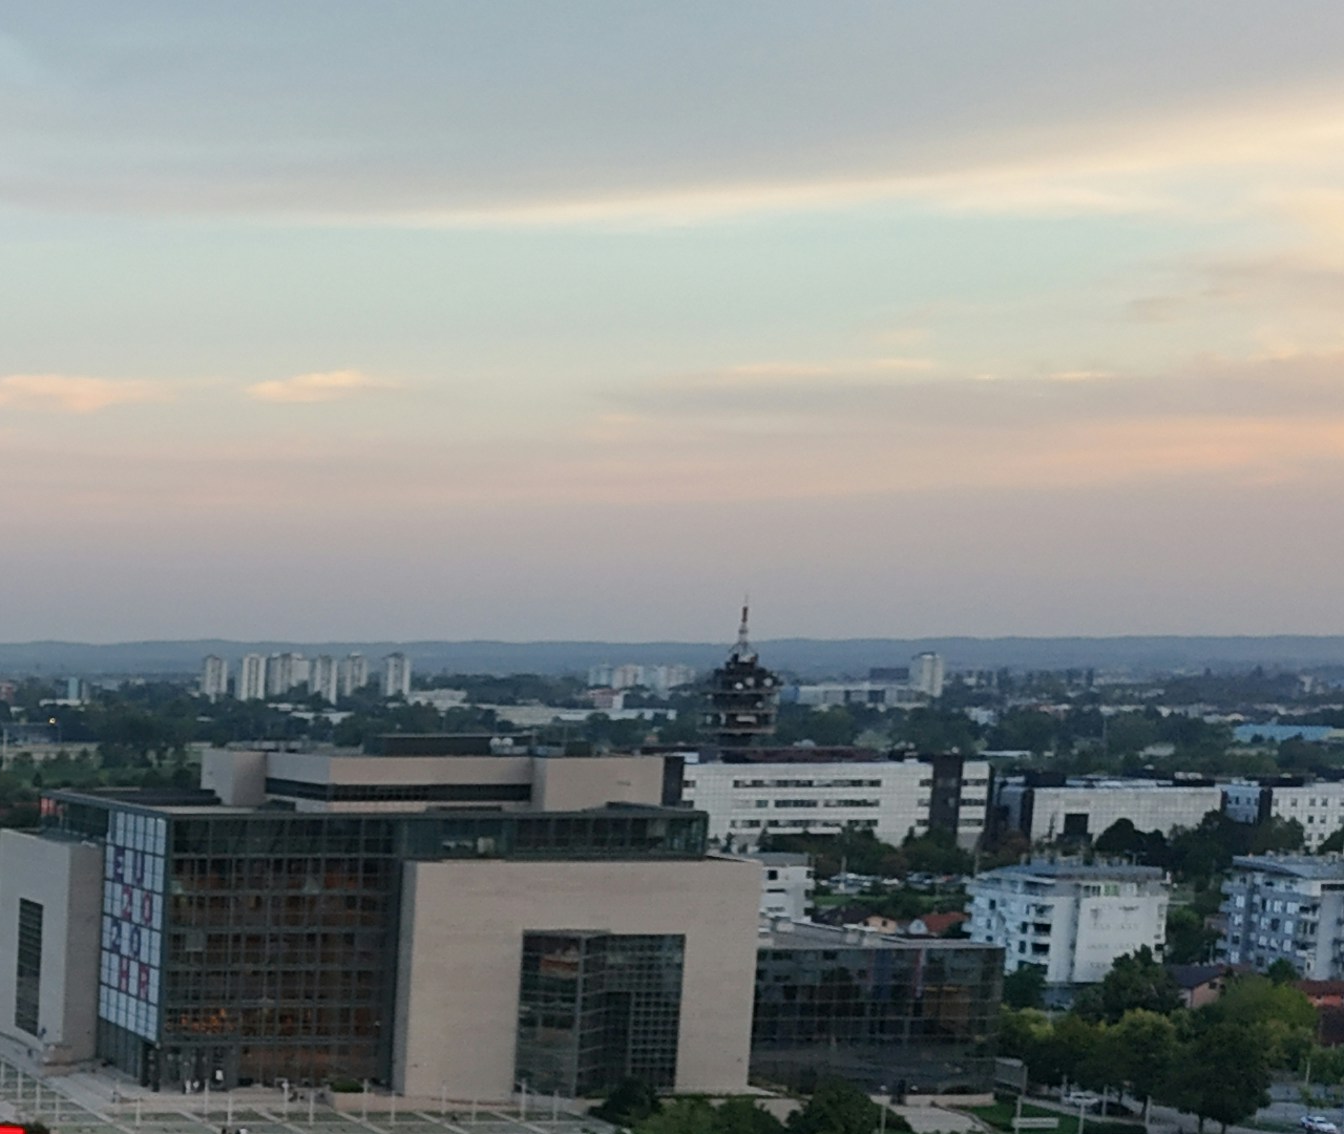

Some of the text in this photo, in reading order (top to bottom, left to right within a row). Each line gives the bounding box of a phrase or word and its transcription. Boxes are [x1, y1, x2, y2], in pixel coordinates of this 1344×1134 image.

[113, 846, 145, 885] EU
[122, 885, 153, 926] 20
[111, 919, 141, 959] 20
[118, 957, 150, 999] HR
